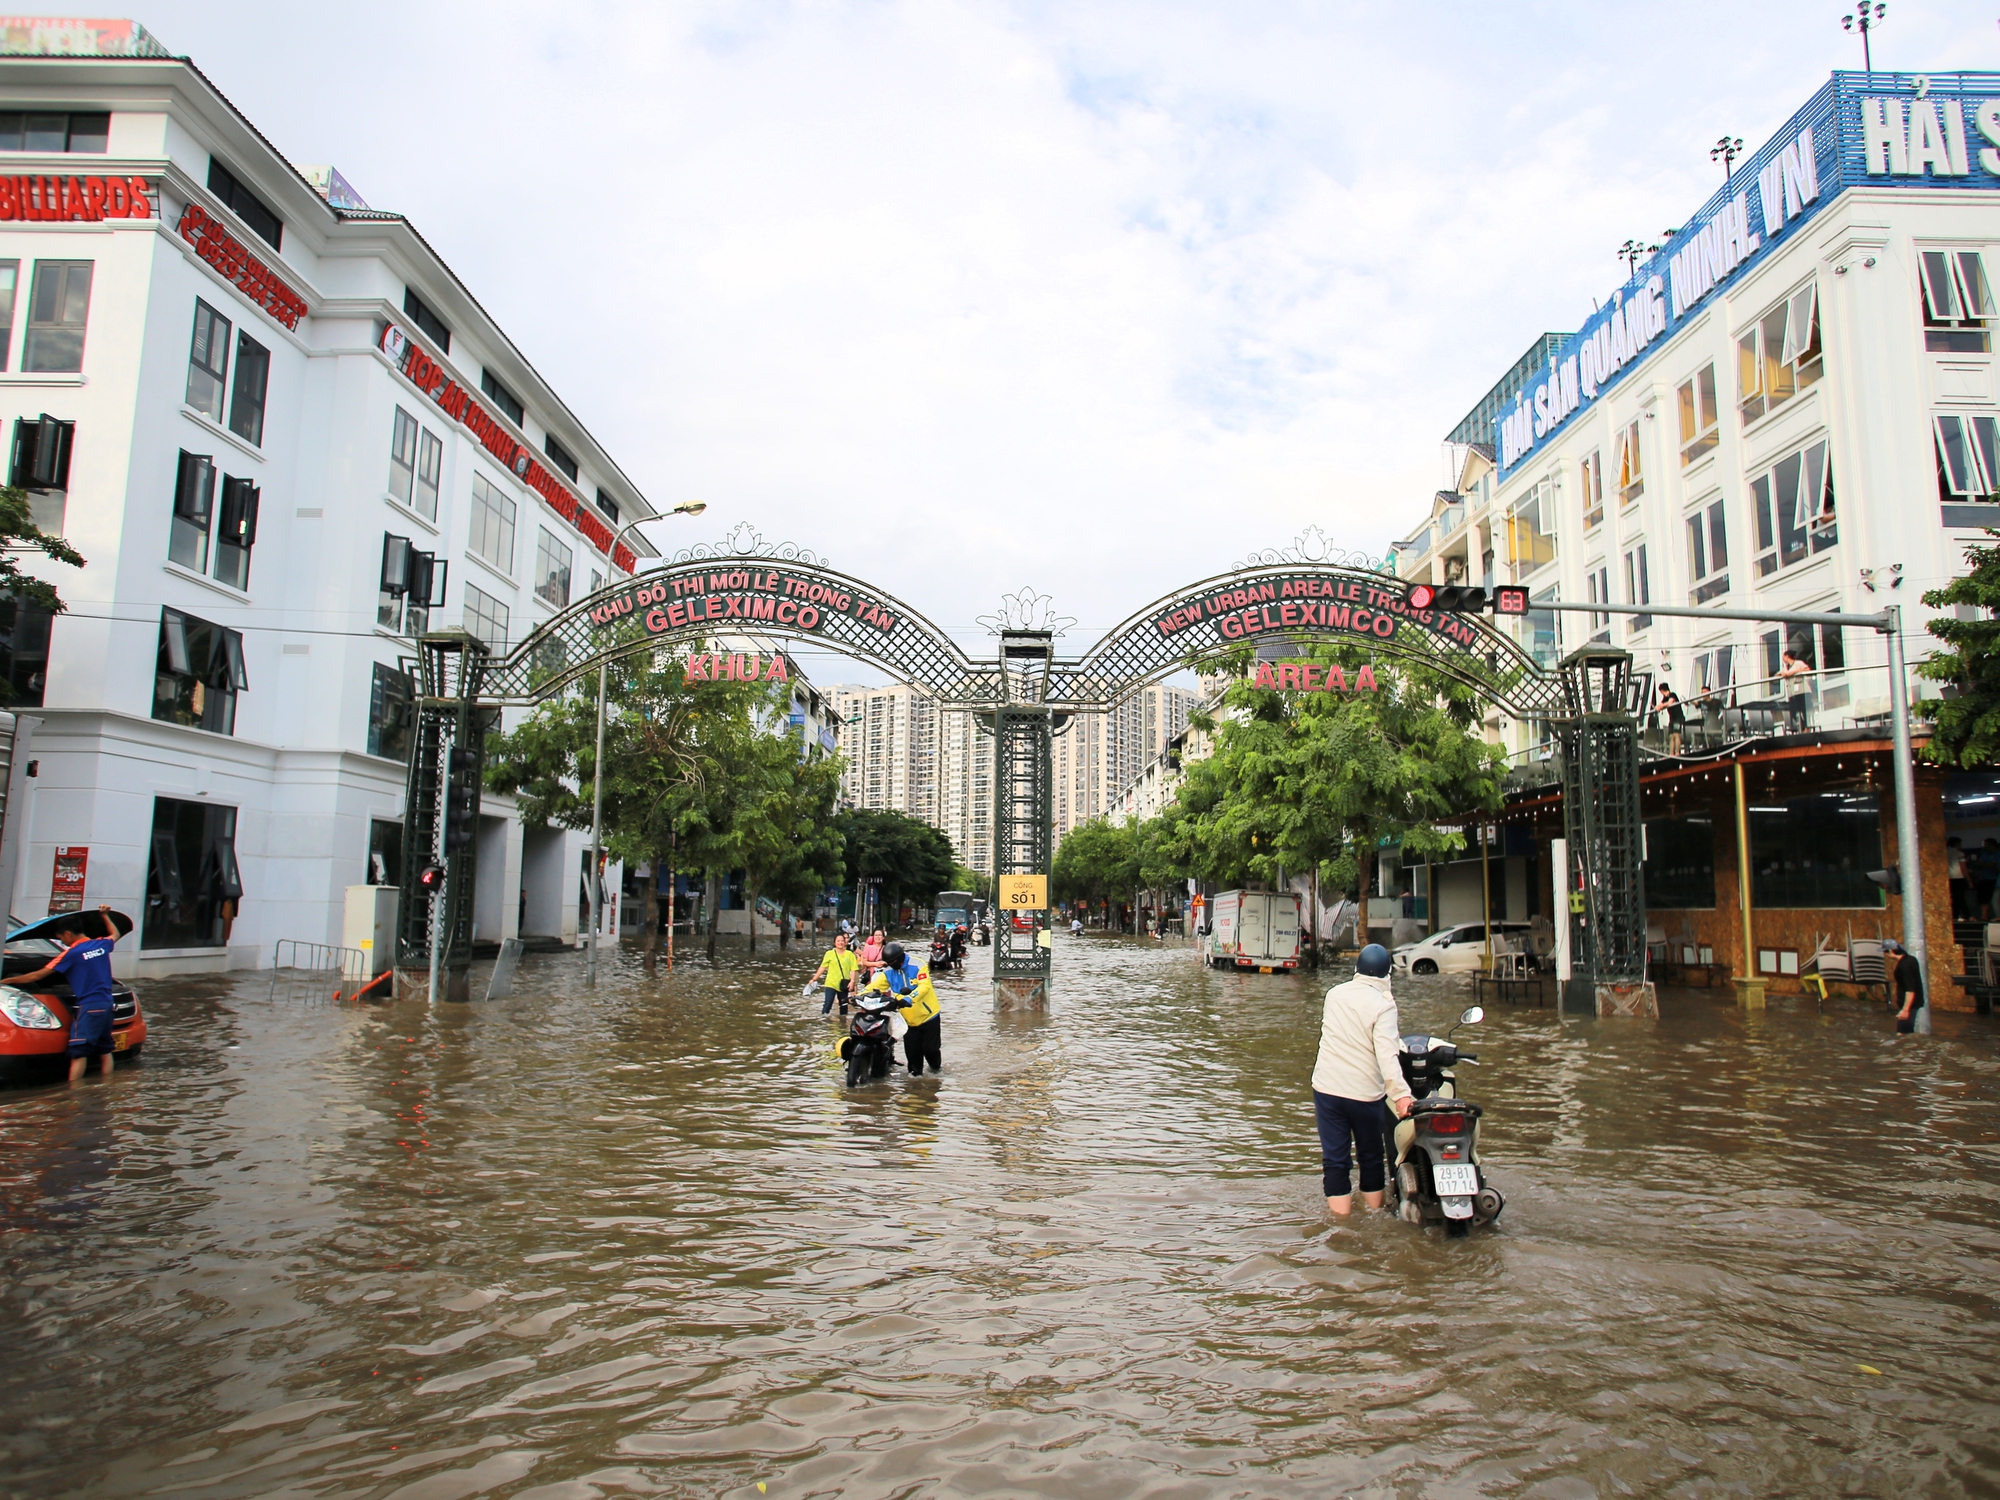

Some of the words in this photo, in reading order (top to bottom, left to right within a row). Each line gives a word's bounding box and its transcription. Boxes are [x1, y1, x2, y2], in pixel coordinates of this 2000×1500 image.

[1861, 74, 1969, 176] HẢI
[196, 236, 239, 279] 0929
[237, 271, 269, 306] 244
[266, 296, 296, 330] 244
[221, 237, 248, 266] A22
[246, 258, 308, 317] GELEXIMCO
[1501, 390, 1534, 470] HẢI
[1534, 356, 1580, 439] SẢN
[1579, 274, 1666, 400] QUẢNG
[406, 344, 444, 395] TOP
[437, 380, 469, 422] AN
[463, 401, 516, 465] KHANH
[525, 459, 579, 523] BILLIARDS
[580, 509, 615, 557] FITNESS
[589, 595, 634, 627] KHU
[637, 582, 667, 607] ĐÔ
[670, 575, 704, 595] THỊ
[710, 570, 750, 591] MỚI
[753, 571, 780, 592] LÊ
[784, 577, 851, 611] TRỌNG
[855, 600, 895, 631] TẤN
[646, 596, 819, 633] GELEXIMCO
[1157, 602, 1203, 637] NEW
[1204, 583, 1276, 615] URBAN
[1280, 580, 1334, 598] AREA
[1337, 582, 1362, 602] LE
[1436, 613, 1476, 647] TAN
[1500, 590, 1525, 612] 63
[1220, 603, 1394, 639] GELEXIMCO
[687, 653, 761, 682] KHU
[764, 655, 788, 683] A
[1253, 662, 1348, 692] AREA
[1354, 664, 1379, 692] A
[1011, 890, 1028, 904] SỐ
[1031, 893, 1036, 904] 1
[1438, 1180, 1475, 1193] 017.14
[1440, 1167, 1469, 1180] 29-B1
